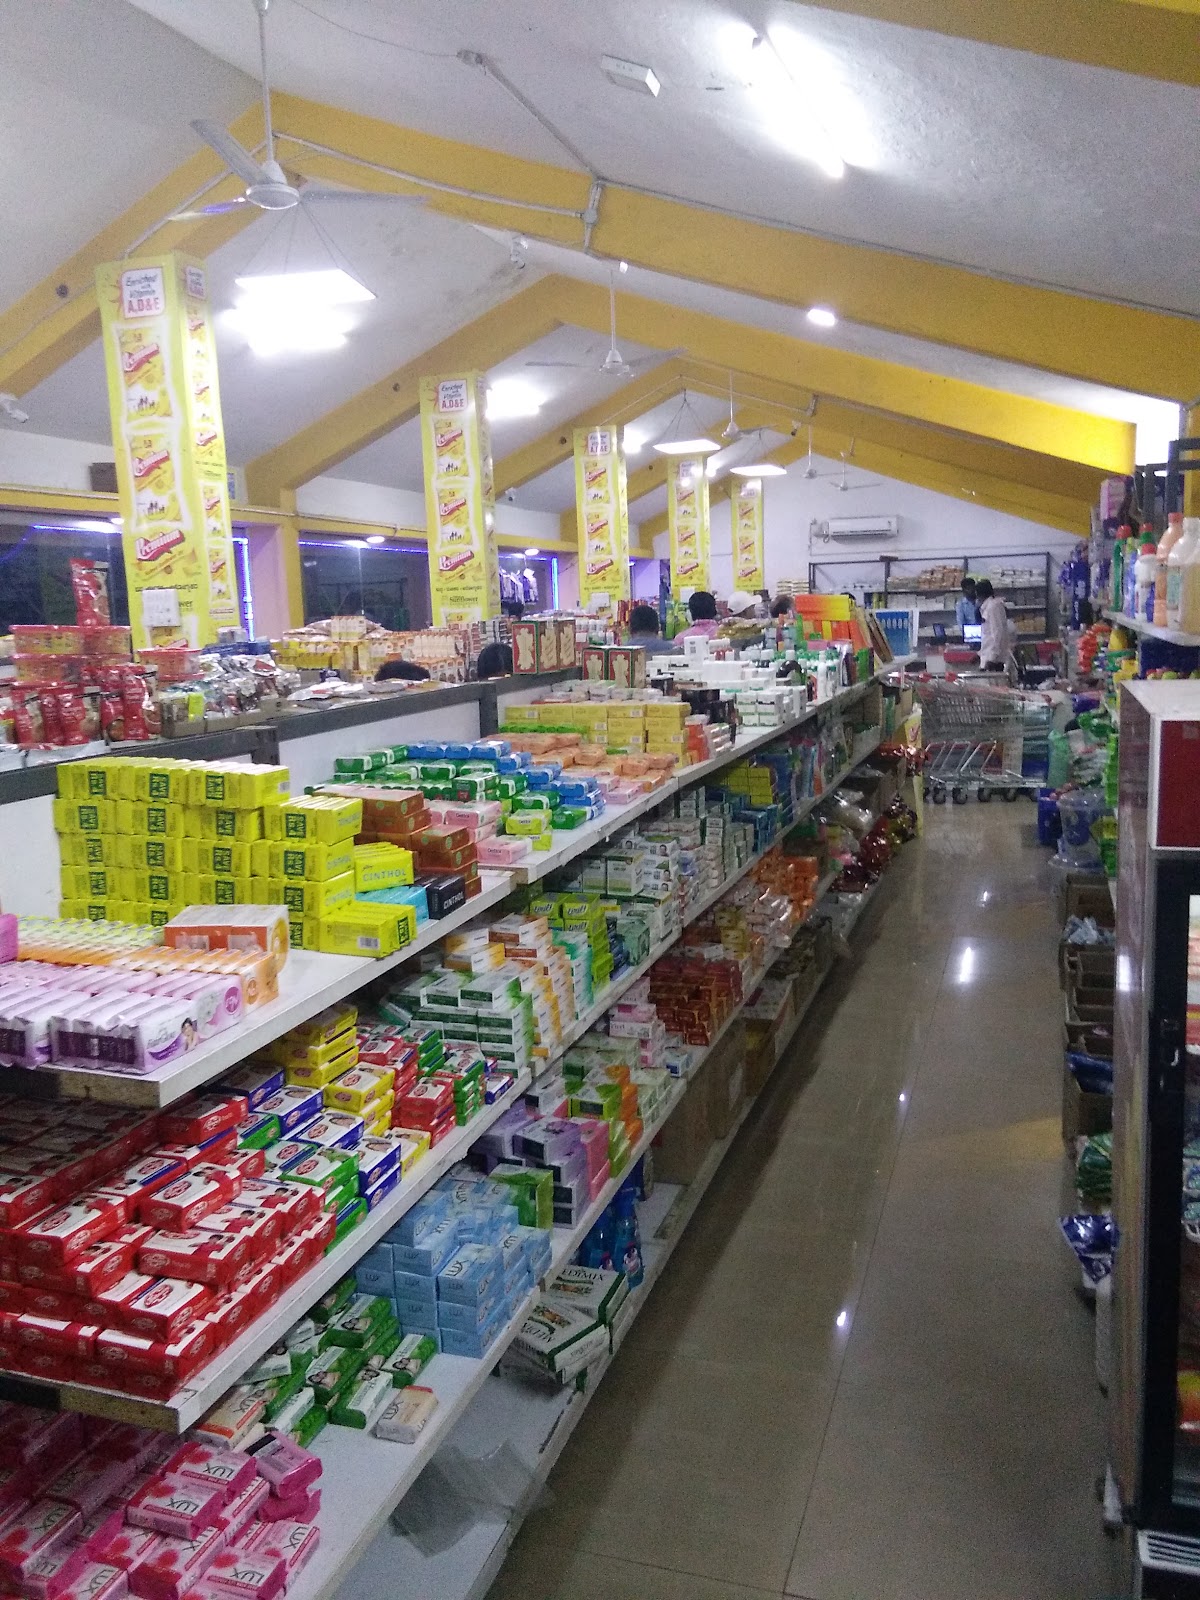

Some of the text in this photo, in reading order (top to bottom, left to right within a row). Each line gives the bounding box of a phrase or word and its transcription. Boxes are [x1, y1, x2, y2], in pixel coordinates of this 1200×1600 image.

[135, 529, 184, 561] Premium
[439, 551, 473, 571] Premium
[363, 868, 407, 882] CINTHOL
[443, 891, 465, 910] CINTHOL
[434, 1219, 451, 1234] LUX
[503, 1235, 518, 1249] LUX
[446, 1259, 470, 1277] LUX
[562, 1268, 606, 1281] EDIMIX
[383, 1400, 404, 1420] LUX
[203, 1463, 235, 1478] LUX
[166, 1497, 200, 1513] LUX
[34, 1507, 68, 1531] LUX
[283, 1526, 310, 1549] LUX
[80, 1569, 116, 1594] LUX
[230, 1568, 265, 1584] LUX
